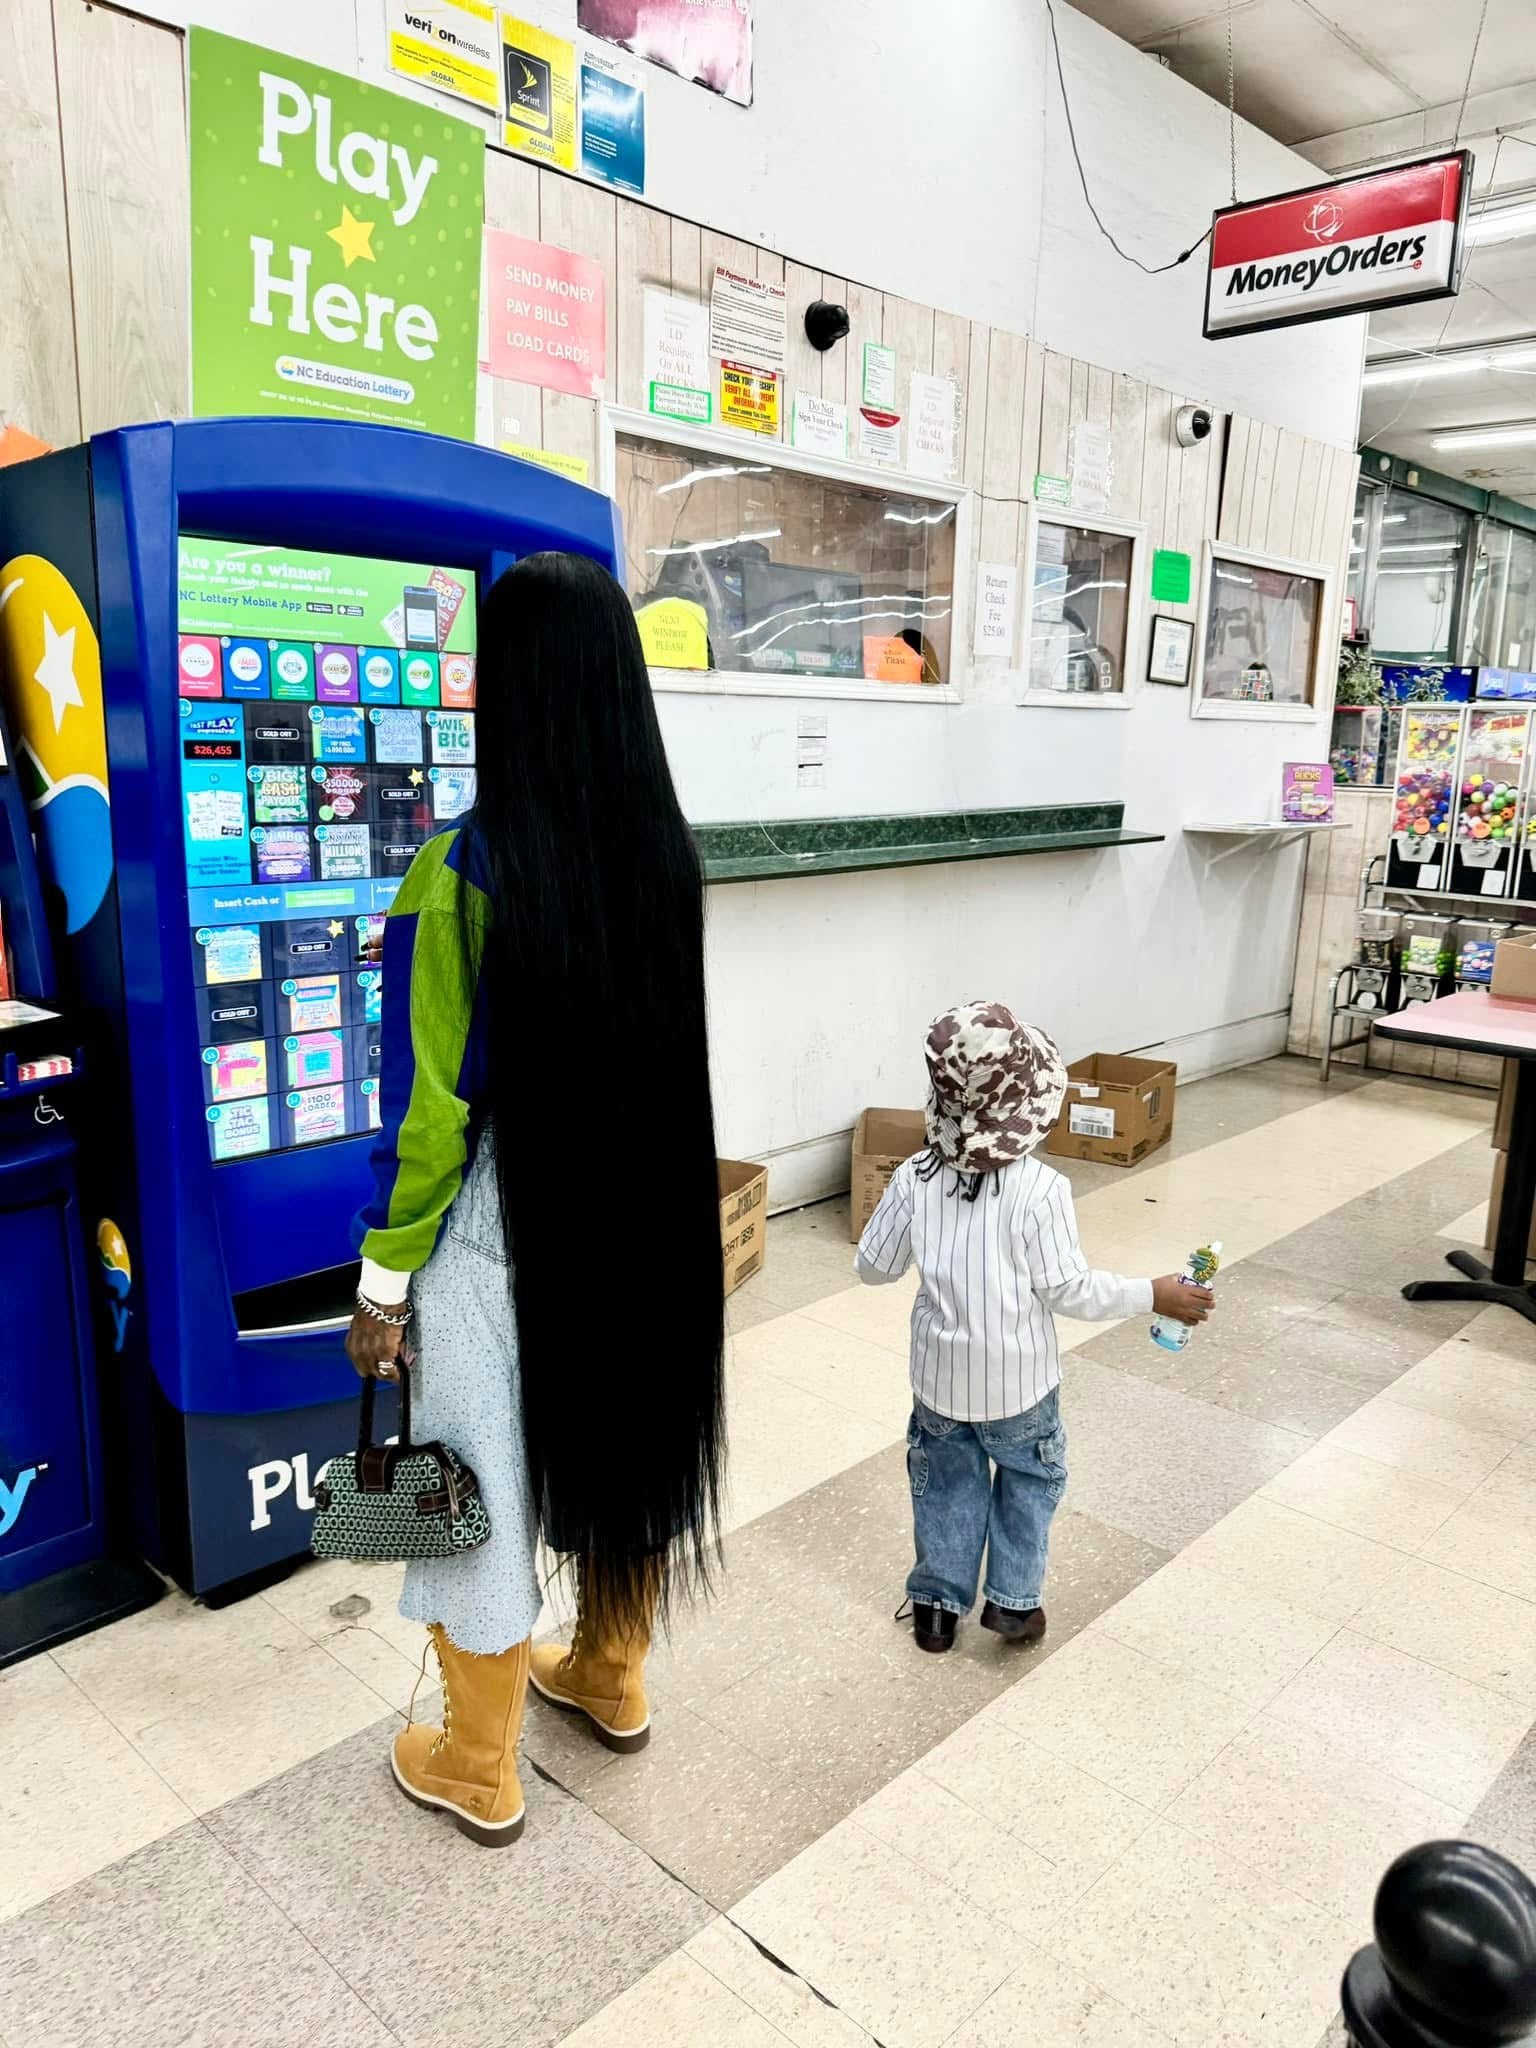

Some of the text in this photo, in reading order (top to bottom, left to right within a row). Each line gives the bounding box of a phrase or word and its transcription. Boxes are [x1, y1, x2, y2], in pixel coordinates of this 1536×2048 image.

[456, 40, 490, 60] wireless
[517, 89, 540, 108] Sprint
[258, 71, 438, 226] Play
[1226, 235, 1427, 297] MoneyOrders
[505, 264, 595, 303] SEND MONEY
[250, 234, 438, 361] Here
[506, 298, 569, 328] PAY BILLS
[507, 330, 591, 364] LOAD CARDS
[296, 365, 410, 400] NC Education Lottery
[724, 371, 740, 384] CHECK
[755, 379, 775, 392] ECEIPT
[808, 399, 820, 411] Do
[180, 552, 332, 582] Are you a winner?
[985, 575, 1008, 589] Return
[180, 590, 196, 601] NC
[201, 591, 239, 605] Lottery
[242, 595, 277, 608] Mobile
[281, 600, 302, 613] App
[985, 592, 1007, 605] Check
[659, 615, 679, 625] NEXT
[988, 608, 1001, 621] Fee
[652, 626, 689, 638] WINDOW
[983, 625, 1006, 637] $25.00
[656, 640, 684, 652] PLEASE
[207, 717, 238, 729] PLAY
[280, 730, 292, 738] OUT
[438, 732, 470, 748] BIG
[262, 782, 299, 796] CASH
[214, 896, 280, 908] Insert Cash or
[231, 1105, 252, 1117] TIC
[230, 1117, 254, 1129] TAC
[224, 1125, 260, 1139] BONUS
